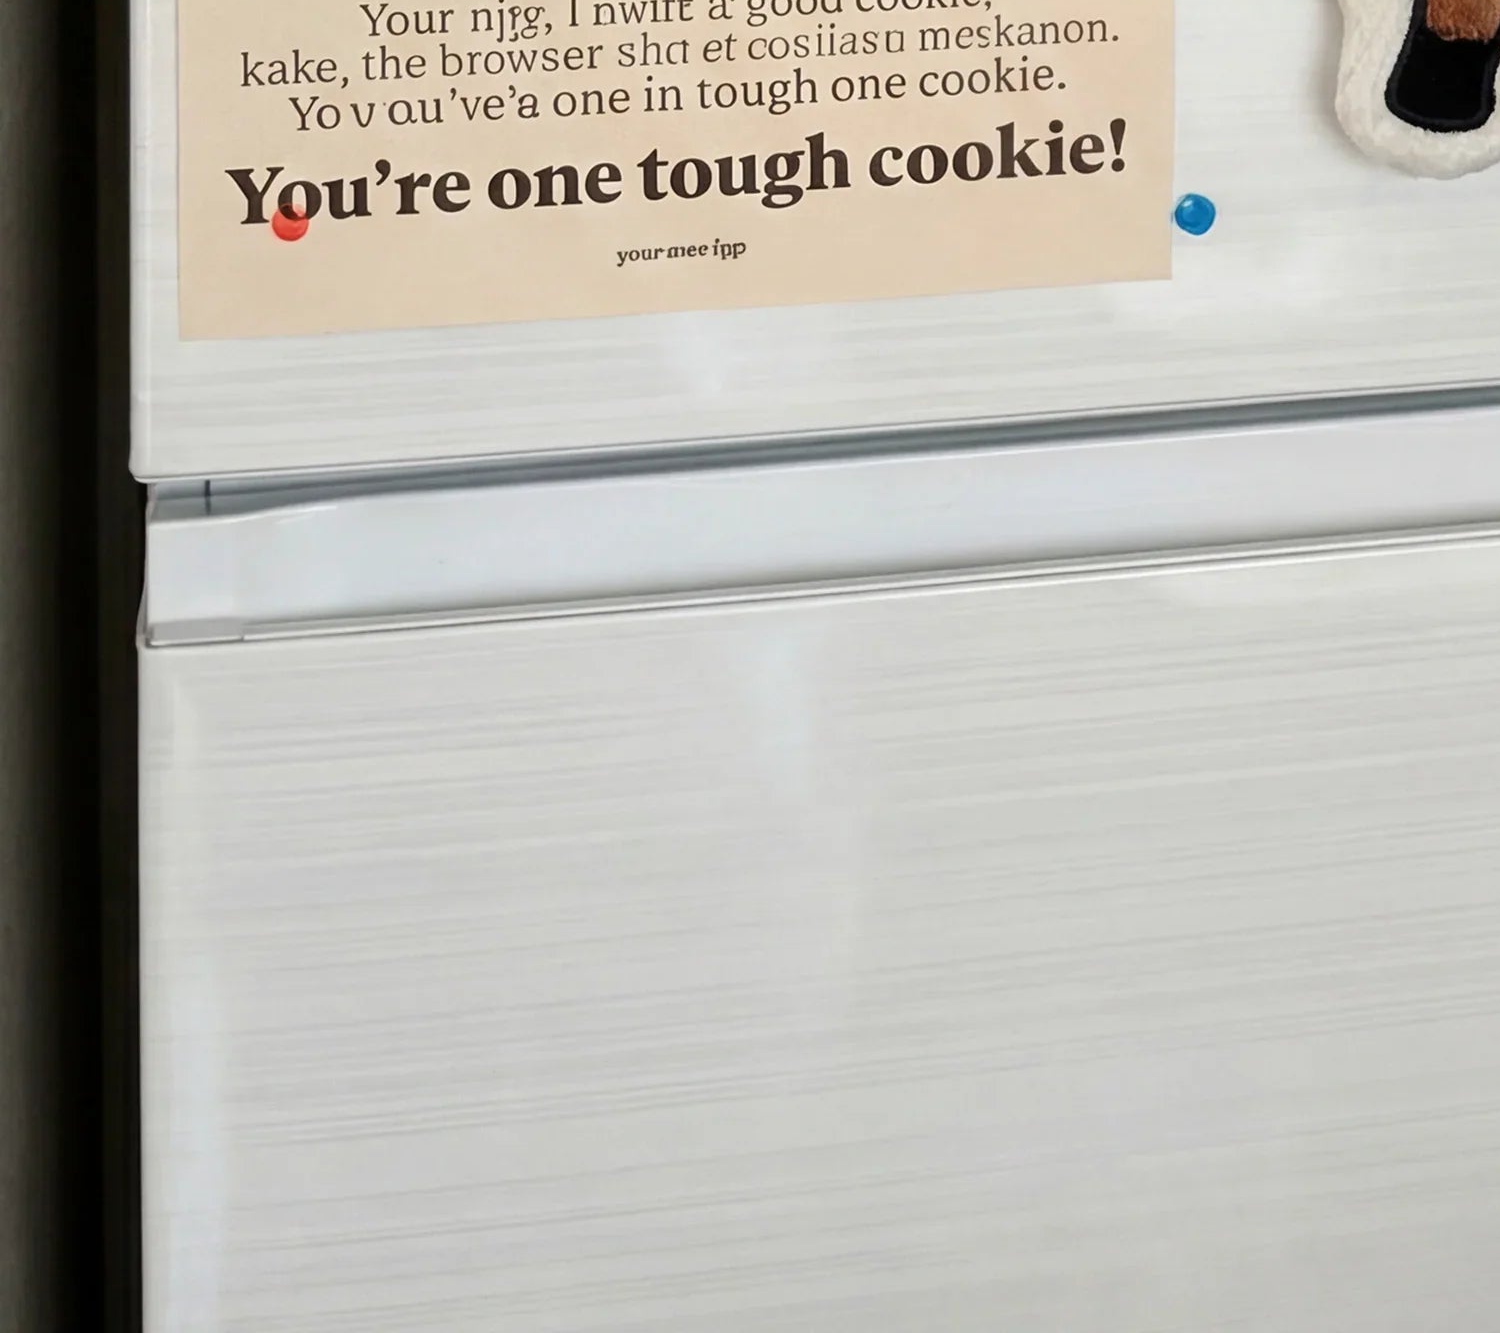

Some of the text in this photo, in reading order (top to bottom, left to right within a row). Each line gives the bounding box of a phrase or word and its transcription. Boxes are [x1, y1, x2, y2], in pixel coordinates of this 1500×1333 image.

[239, 48, 350, 90] kake,
[361, 44, 428, 82] the
[438, 41, 604, 78] browser
[701, 32, 738, 64] et
[917, 13, 1120, 53] meskanon.
[359, 2, 455, 37] Your
[552, 87, 631, 117] one
[643, 74, 684, 113] in
[696, 67, 819, 116] tough
[830, 71, 907, 102] one
[918, 54, 1067, 97] cookie.
[224, 117, 1127, 226] You're one tough cookie!
